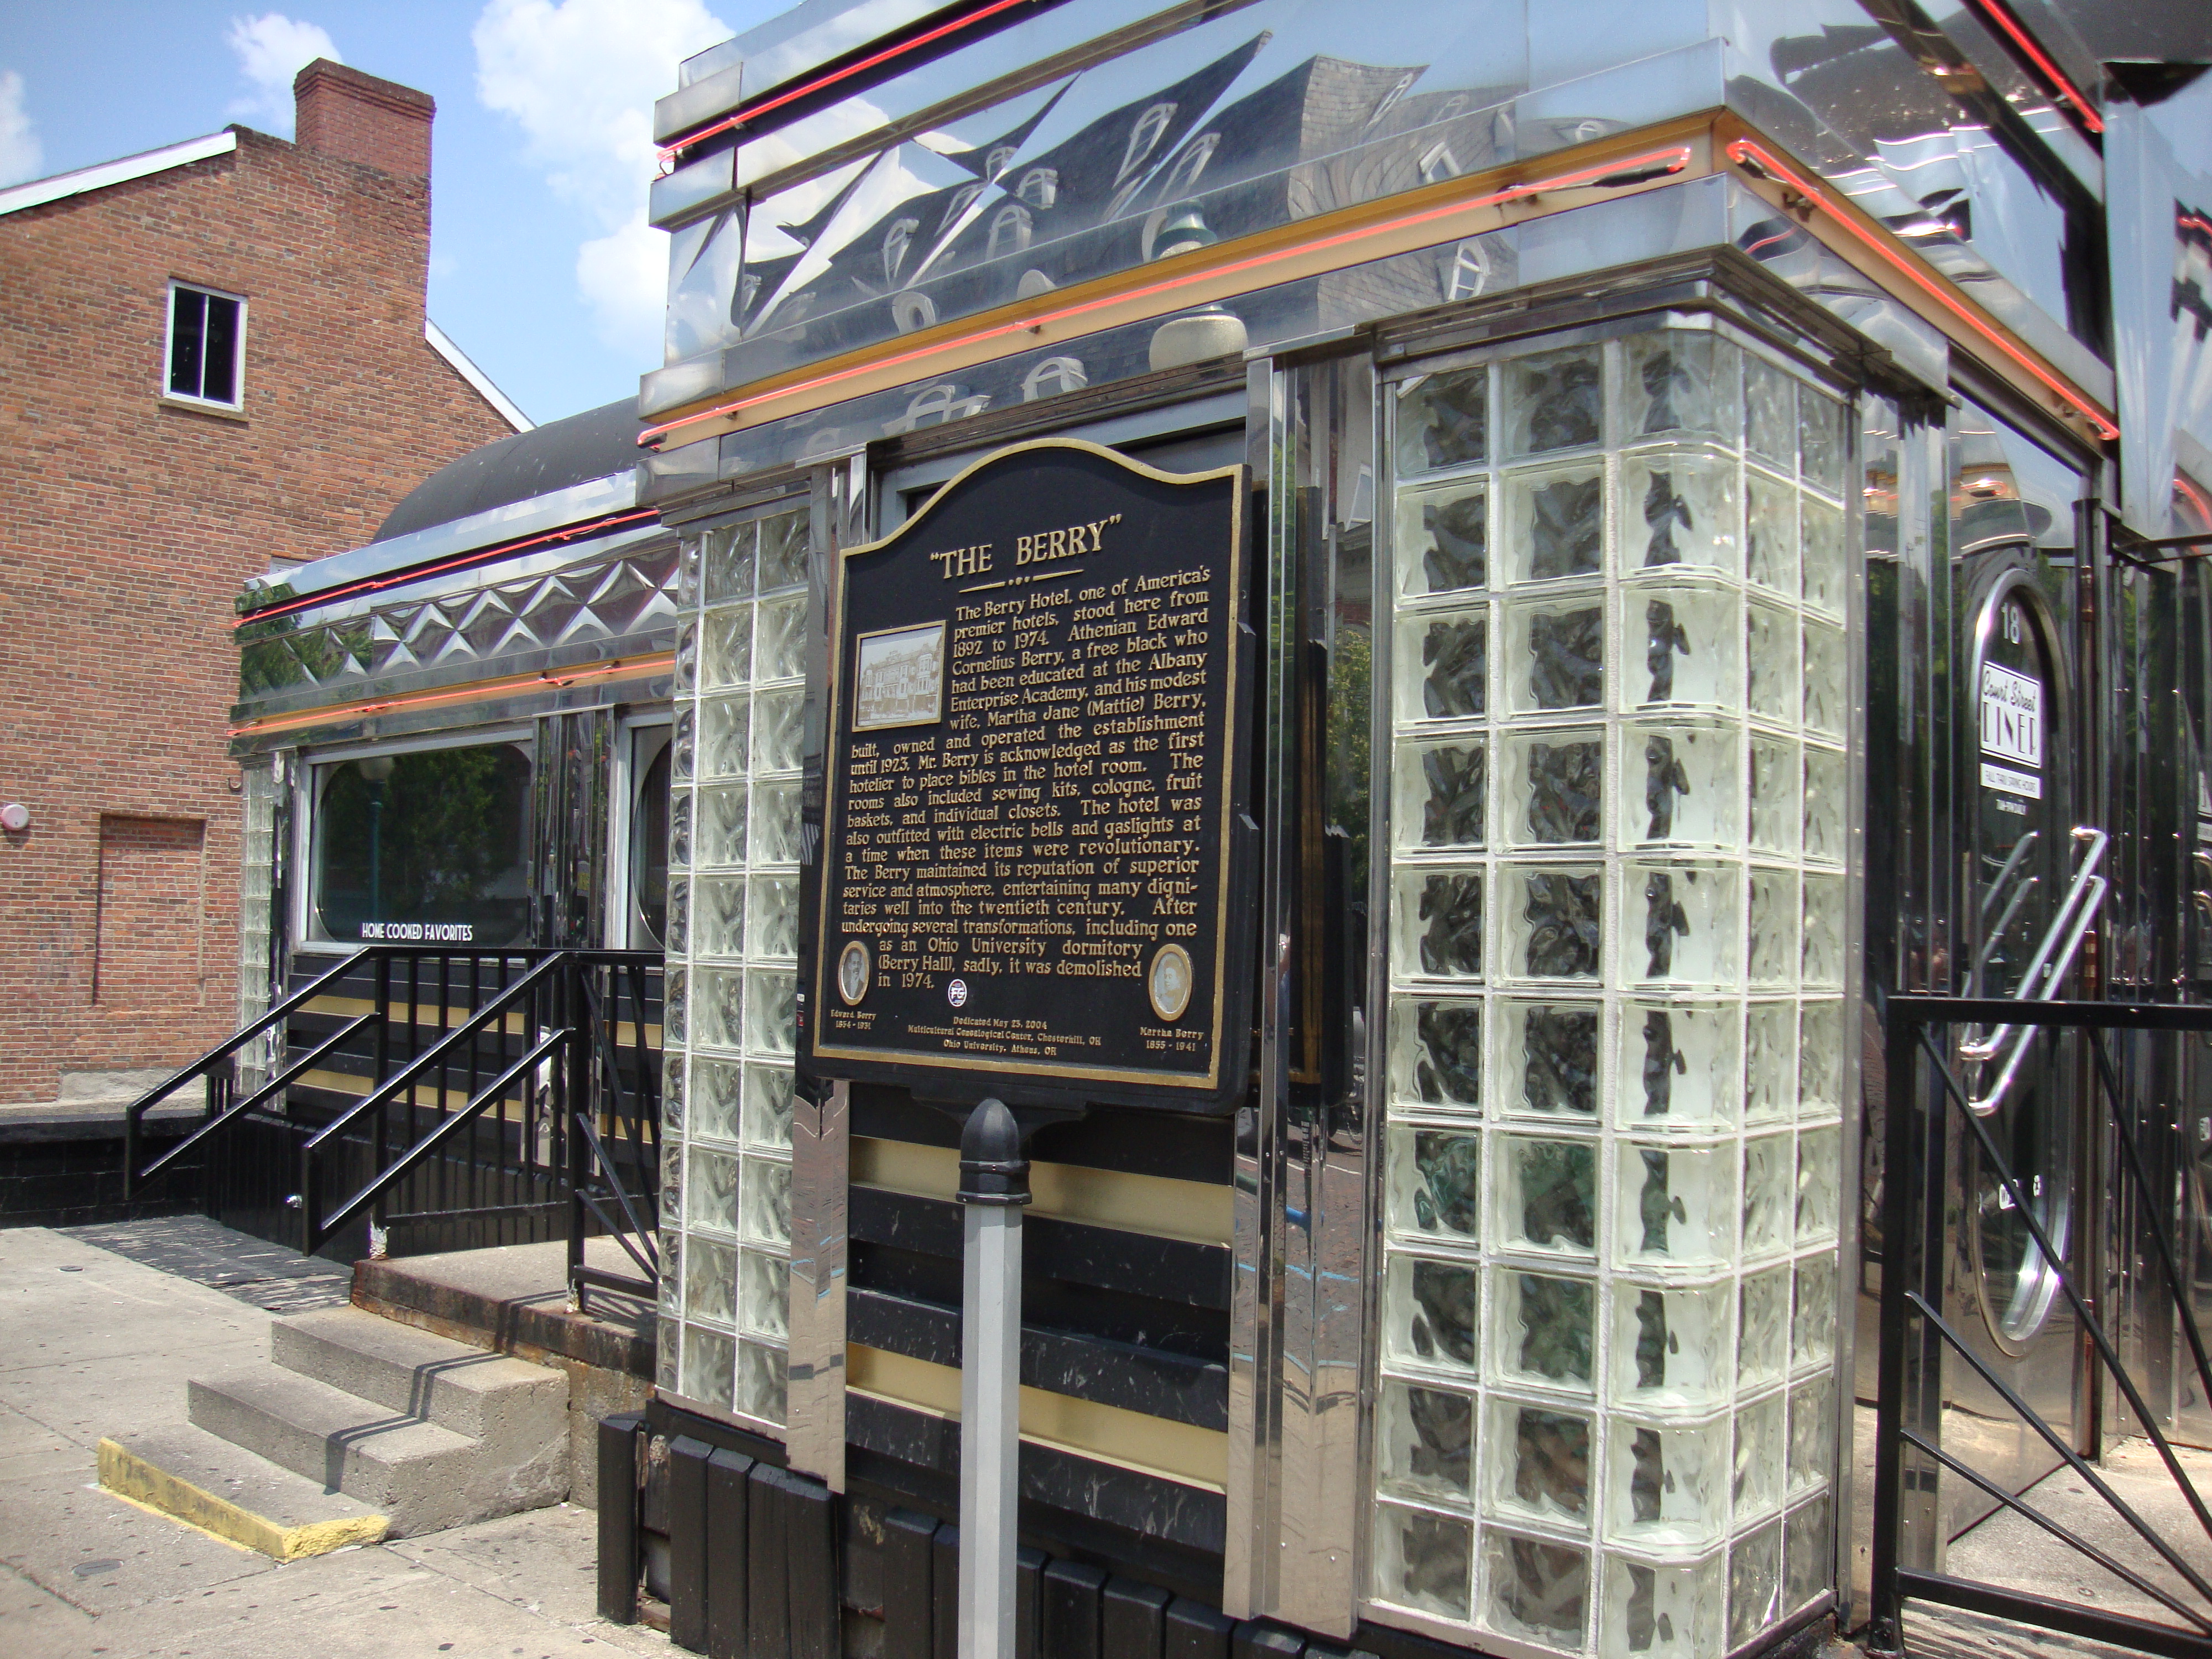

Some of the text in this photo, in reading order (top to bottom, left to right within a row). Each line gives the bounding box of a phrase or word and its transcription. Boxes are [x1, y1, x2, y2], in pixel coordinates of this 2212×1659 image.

[954, 564, 1211, 621] The Berry Hotel, one of America's
[953, 590, 1210, 643] premier hotels, stood here from
[2000, 602, 2021, 645] 18
[952, 607, 1209, 658] 1892 to 1974. Athenian Edward
[952, 629, 1208, 675] Cornelius Berry, a free black who
[951, 651, 1208, 694] had been educated at the Albany
[950, 669, 1207, 712] Enterprise Academy, and his modest
[1983, 670, 2037, 712] Court Street
[949, 692, 1206, 730] wife, Martha Jane (Mattie) Berry,
[851, 710, 1204, 759] built, owned and operated the establishment
[850, 759, 878, 775] until
[917, 754, 937, 770] Mr.
[941, 752, 979, 768] Berry
[983, 748, 994, 764] is
[999, 739, 1102, 763] acknowledged
[1108, 740, 1125, 754] as
[1132, 735, 1159, 752] the
[1167, 731, 1205, 750] first
[849, 752, 1203, 793] hotelier to place bibles in the hotel room. The
[848, 771, 1203, 810] rooms also included sewing kits, cologne, fruit
[846, 795, 1202, 828] baskets, and individual closets. The hotel was
[846, 814, 1201, 846] also outfitted with electric bells and gaslights at
[844, 836, 1200, 863] a time when these items were revolutionary.
[844, 855, 1199, 881] The Berry maintained its reputation of superior
[842, 876, 1198, 900] service and atmosphere, entertaining many digni-
[842, 896, 1198, 917] taries well into the twentieth century. After
[362, 922, 473, 941] HOME COOKED FAVORITES
[841, 917, 1197, 941] undergoing several transformations, including one
[879, 936, 1143, 959] as an Ohio University dormitory
[878, 953, 1142, 977] (Berry Hall), sadly, it was demolished
[877, 972, 935, 989] in 1974.
[830, 1009, 877, 1021] Edward Berry
[952, 1015, 992, 1026] Dedicated
[993, 1018, 1009, 1028] May
[1025, 1019, 1047, 1030] 2004
[907, 1024, 954, 1035] Multicultural
[1088, 1035, 1101, 1046] OH
[943, 1039, 961, 1048] Ohio
[1044, 1046, 1057, 1056] OH
[1139, 1026, 1204, 1040] Martha Berry
[1146, 1040, 1166, 1050] 1855
[1176, 1041, 1196, 1052] 1941
